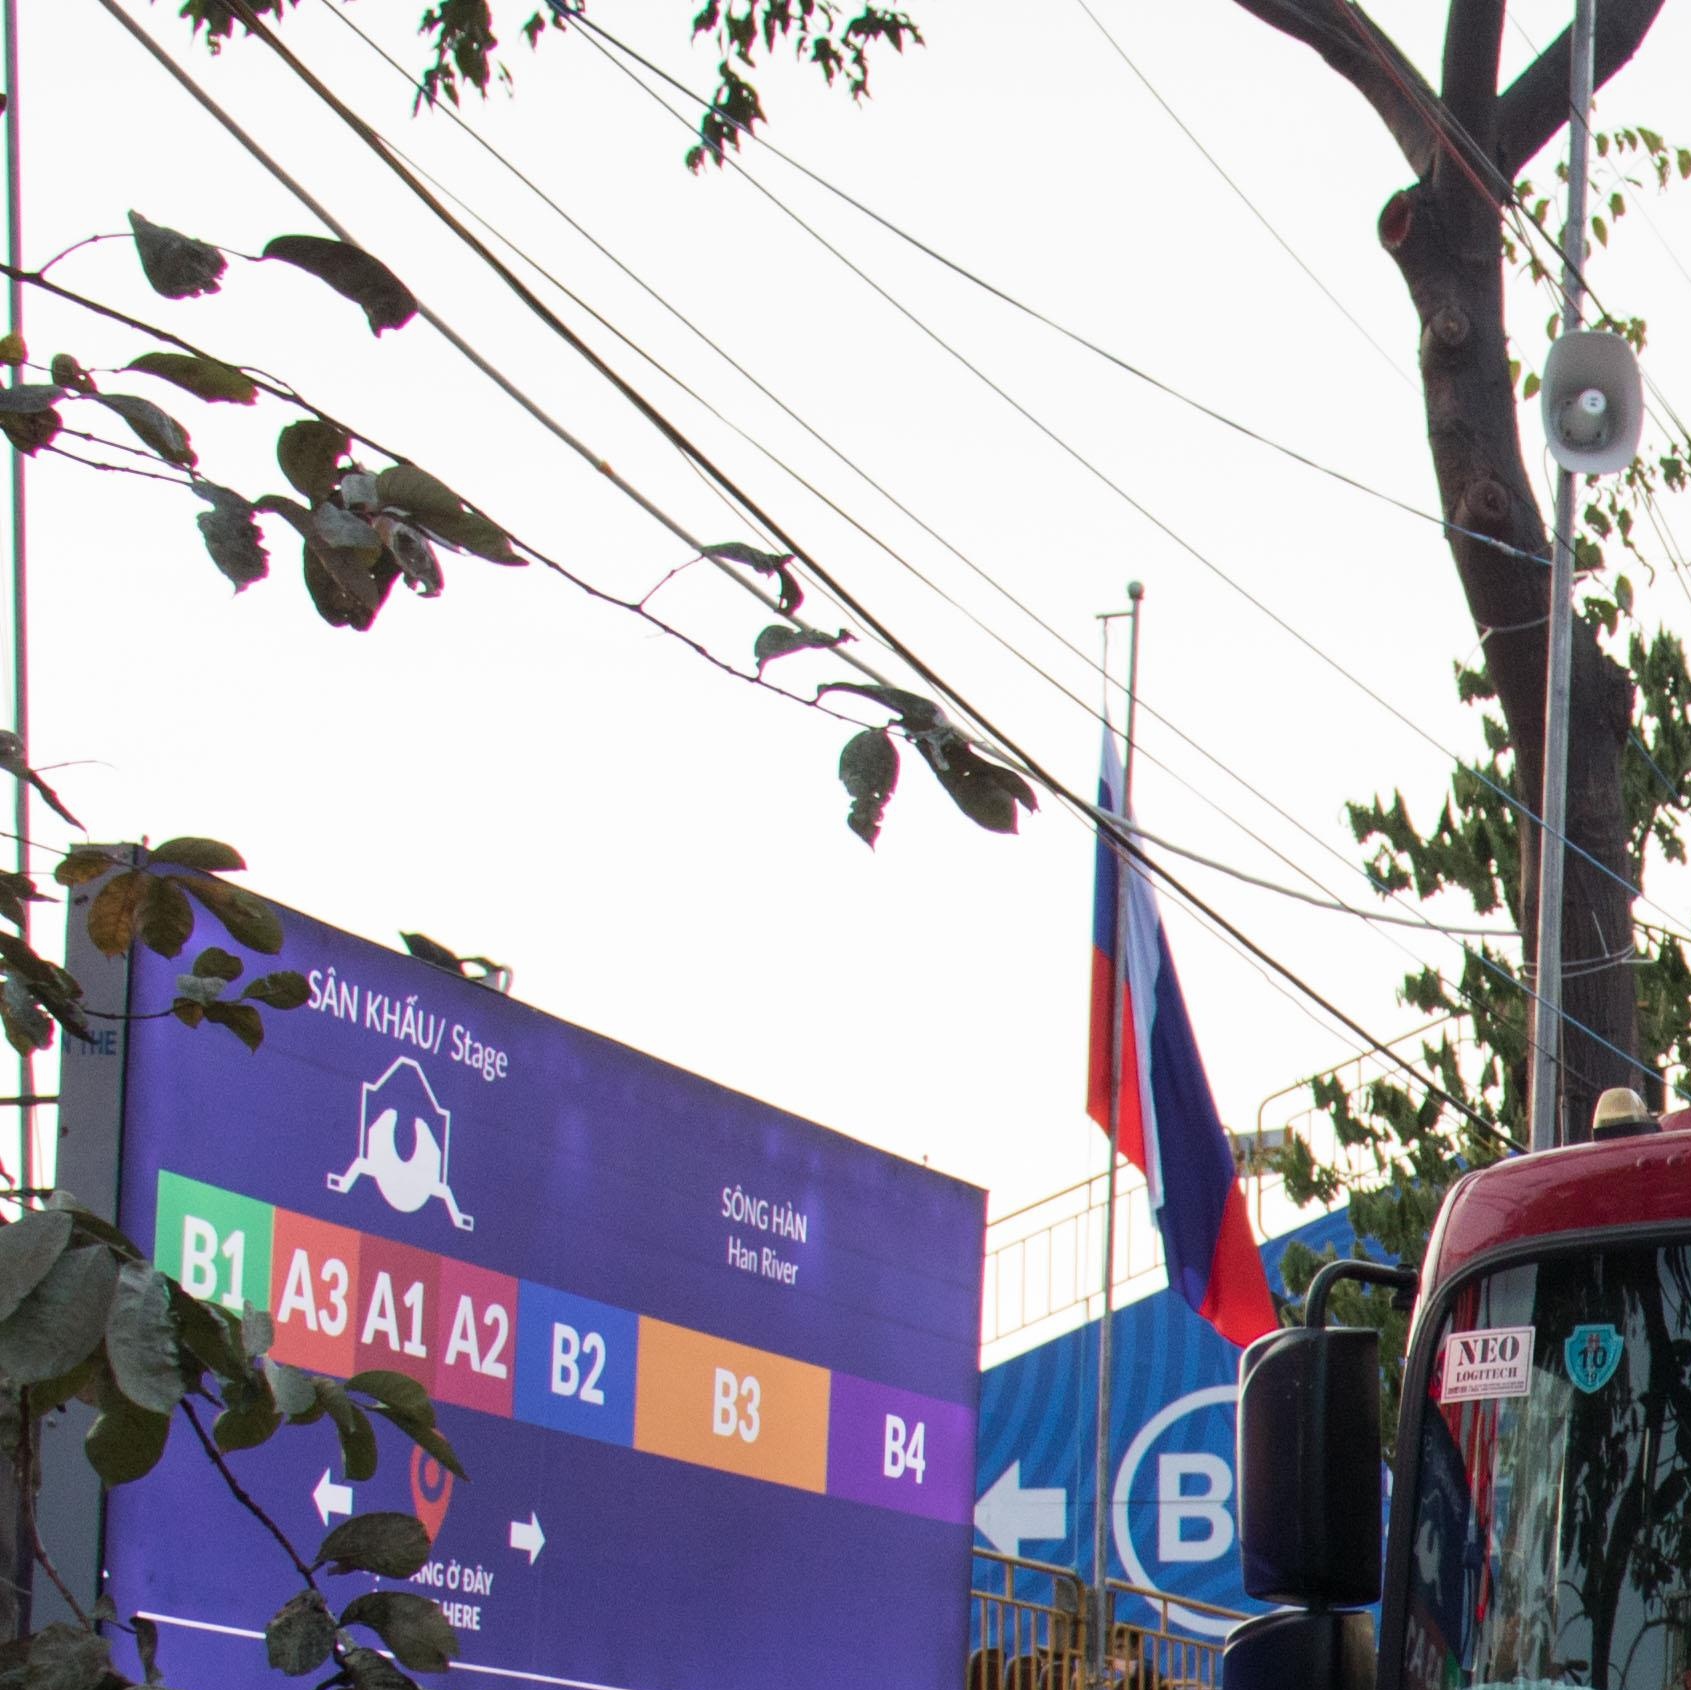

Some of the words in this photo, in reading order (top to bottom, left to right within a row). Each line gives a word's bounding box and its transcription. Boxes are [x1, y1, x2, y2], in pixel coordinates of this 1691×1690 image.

[307, 966, 359, 1024] SÂN
[451, 1024, 508, 1082] Stage
[721, 1184, 769, 1231] SÔNG
[772, 1201, 808, 1244] HÀN
[728, 1235, 758, 1273] Han
[762, 1246, 799, 1285] River
[180, 1214, 246, 1312] B1
[277, 1248, 349, 1337] A3
[360, 1271, 427, 1359] A1
[444, 1294, 507, 1380] A2
[551, 1321, 606, 1406] B2
[712, 1366, 762, 1444] B3
[883, 1413, 926, 1485] B4
[1456, 1366, 1519, 1383] LOGITECH
[1457, 1335, 1520, 1367] NEO
[463, 1564, 495, 1597] ĐÂY
